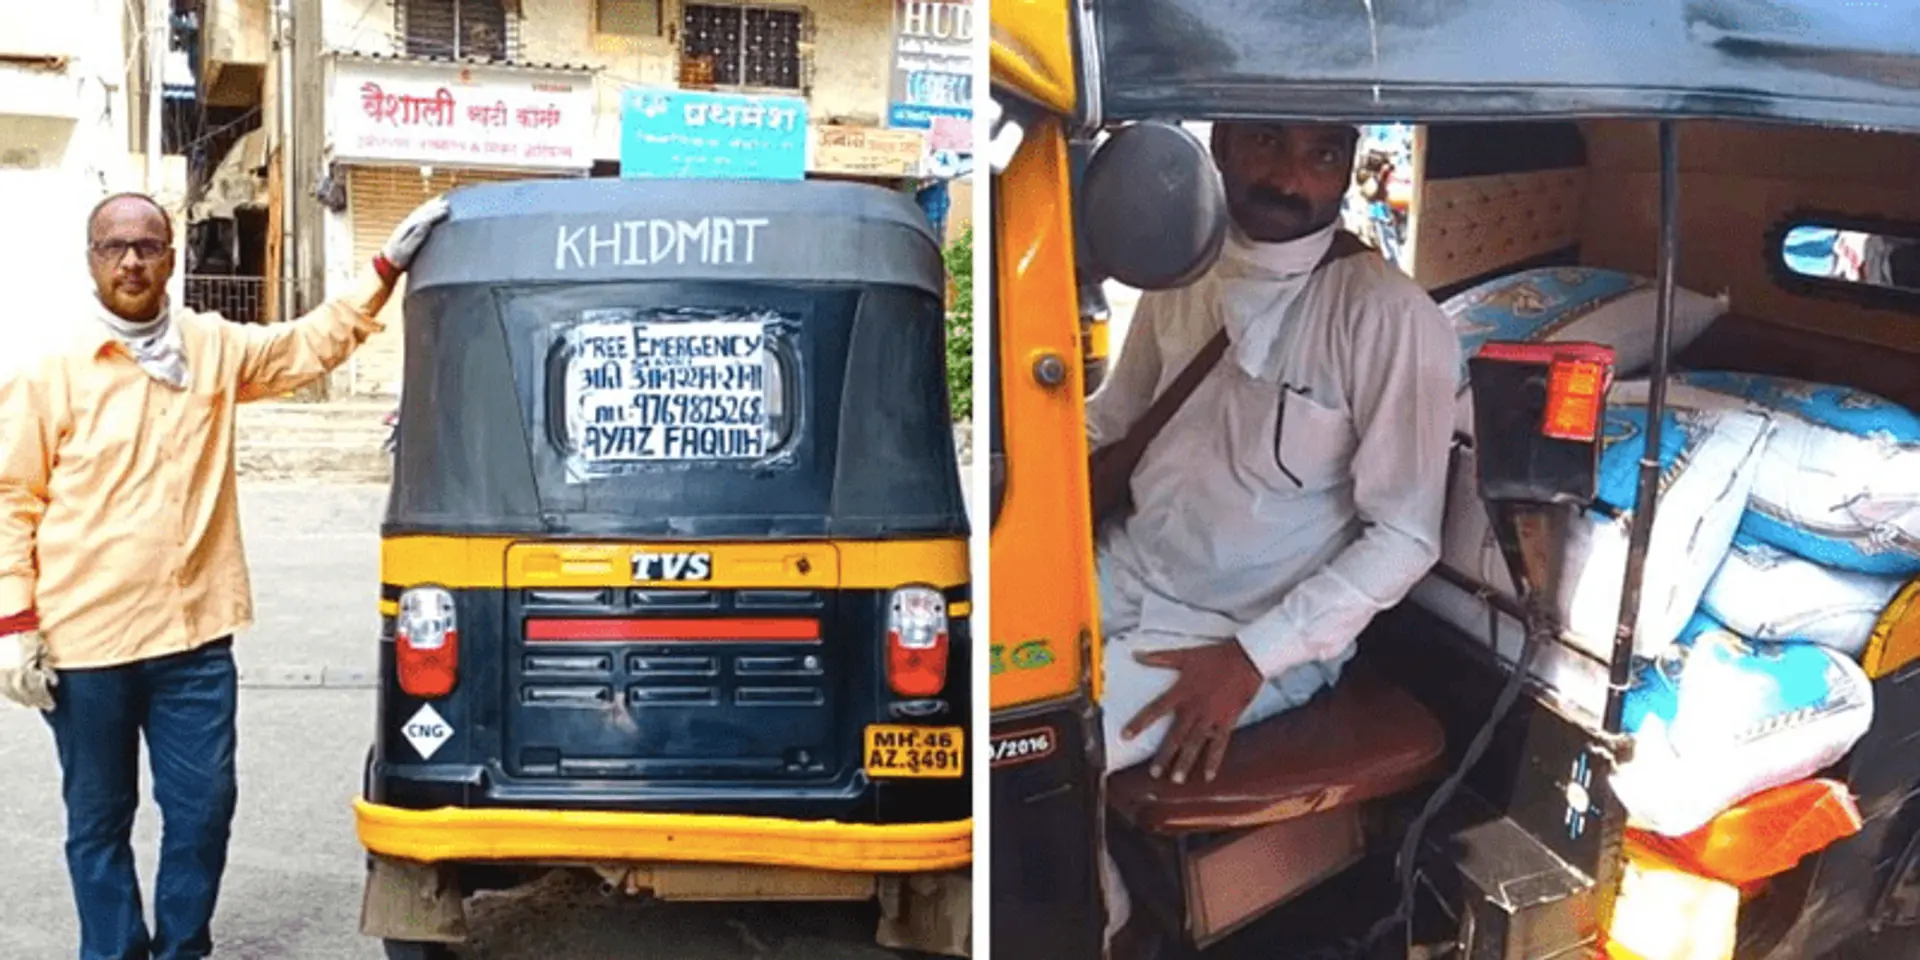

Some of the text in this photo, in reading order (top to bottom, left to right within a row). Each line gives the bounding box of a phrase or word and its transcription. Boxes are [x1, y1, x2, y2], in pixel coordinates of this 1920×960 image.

[360, 80, 456, 127] वैशाली
[555, 217, 770, 270] KHIDMAT
[585, 426, 763, 457] AYAZ FAQUIH
[631, 552, 710, 580] TVS
[408, 723, 444, 738] CNG
